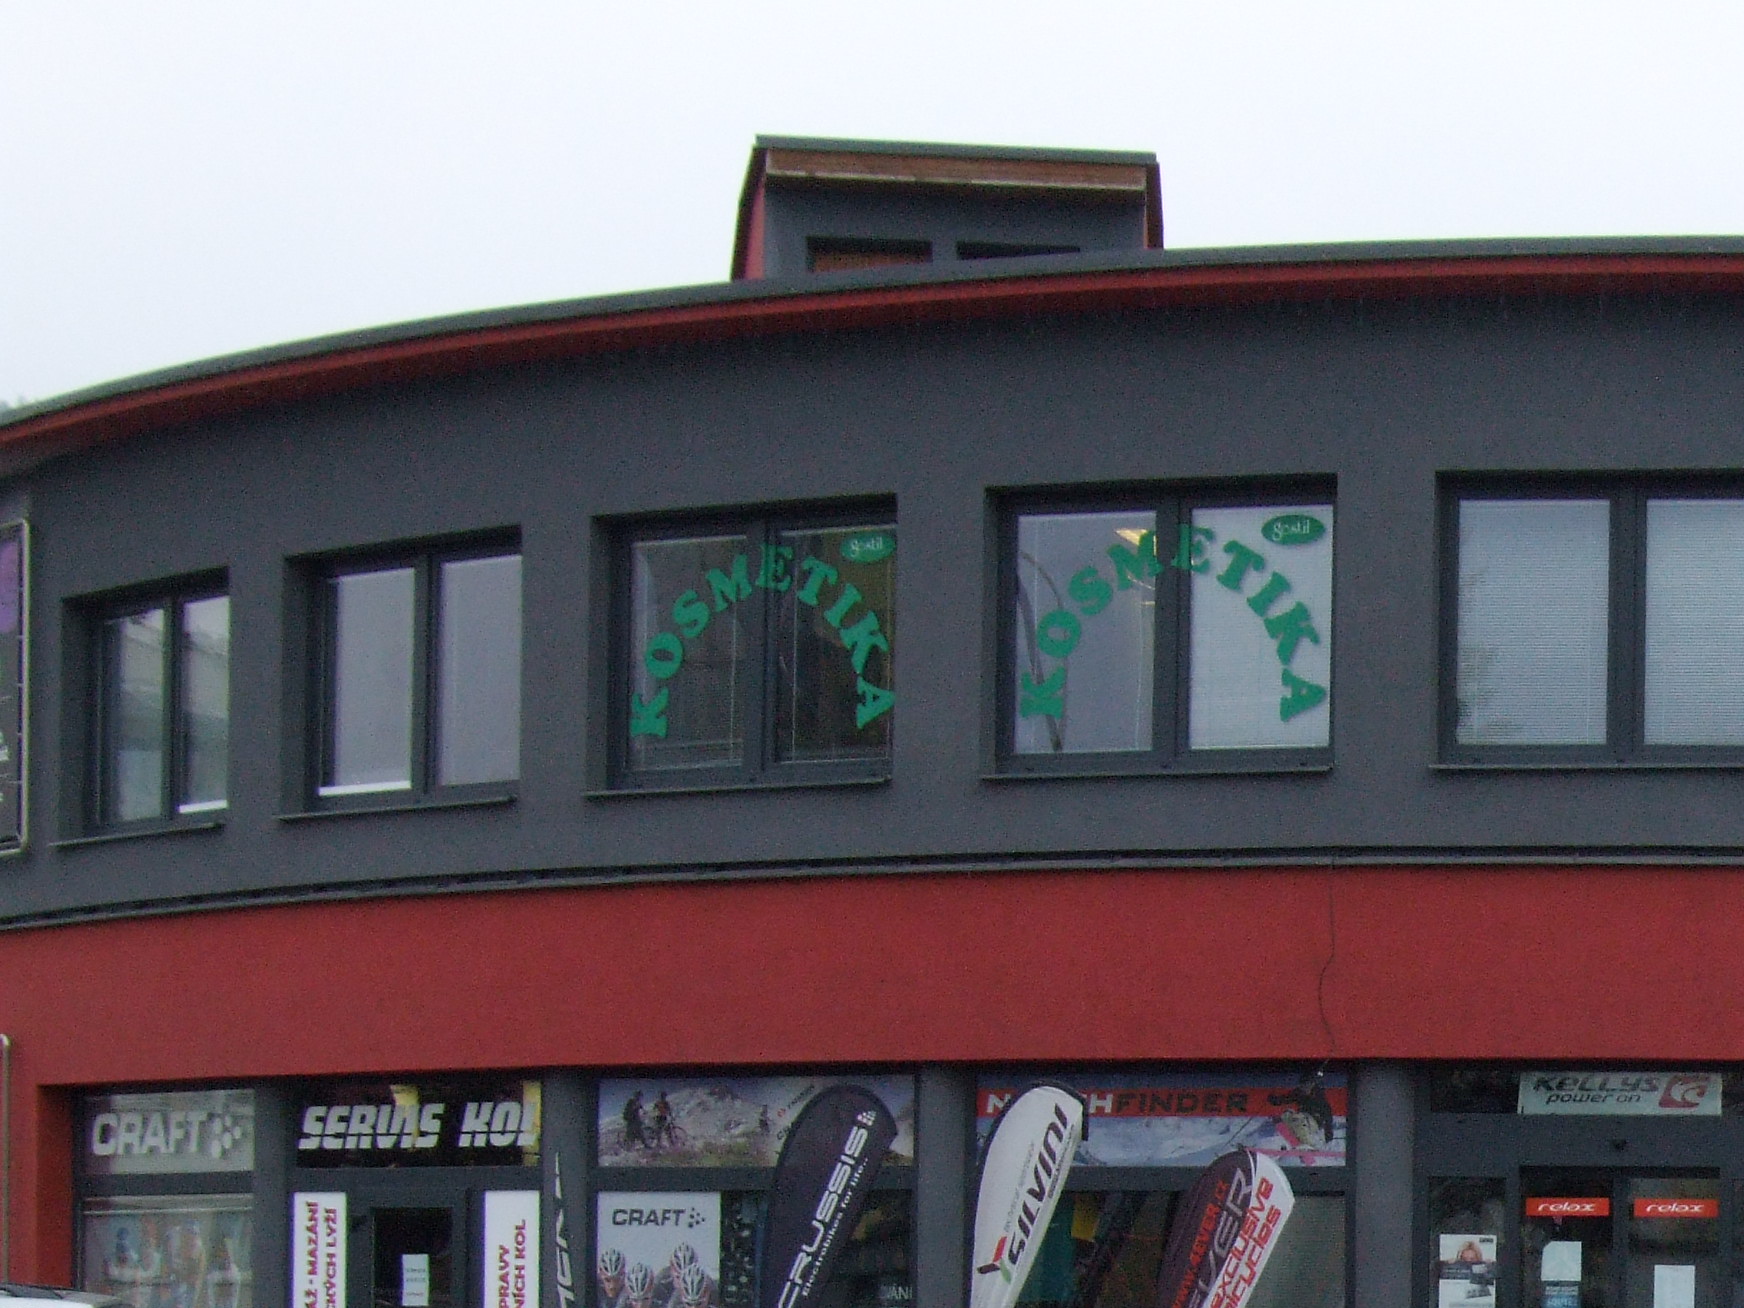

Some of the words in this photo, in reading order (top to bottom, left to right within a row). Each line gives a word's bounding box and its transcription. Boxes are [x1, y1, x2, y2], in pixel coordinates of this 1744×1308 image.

[631, 544, 894, 738] KOSMETIKA
[1022, 524, 1326, 722] KOSMETIKA
[1546, 1092, 1613, 1105] power
[1616, 1093, 1641, 1103] on
[93, 1111, 208, 1156] CRAFT
[298, 1103, 445, 1150] SERVIS
[1008, 1102, 1068, 1265] SILVINI
[612, 1208, 687, 1227] CRAFT
[1538, 1201, 1596, 1212] relax
[1646, 1202, 1705, 1213] relax
[306, 1201, 319, 1276] MAZÁNÍ
[515, 1218, 527, 1260] KOL
